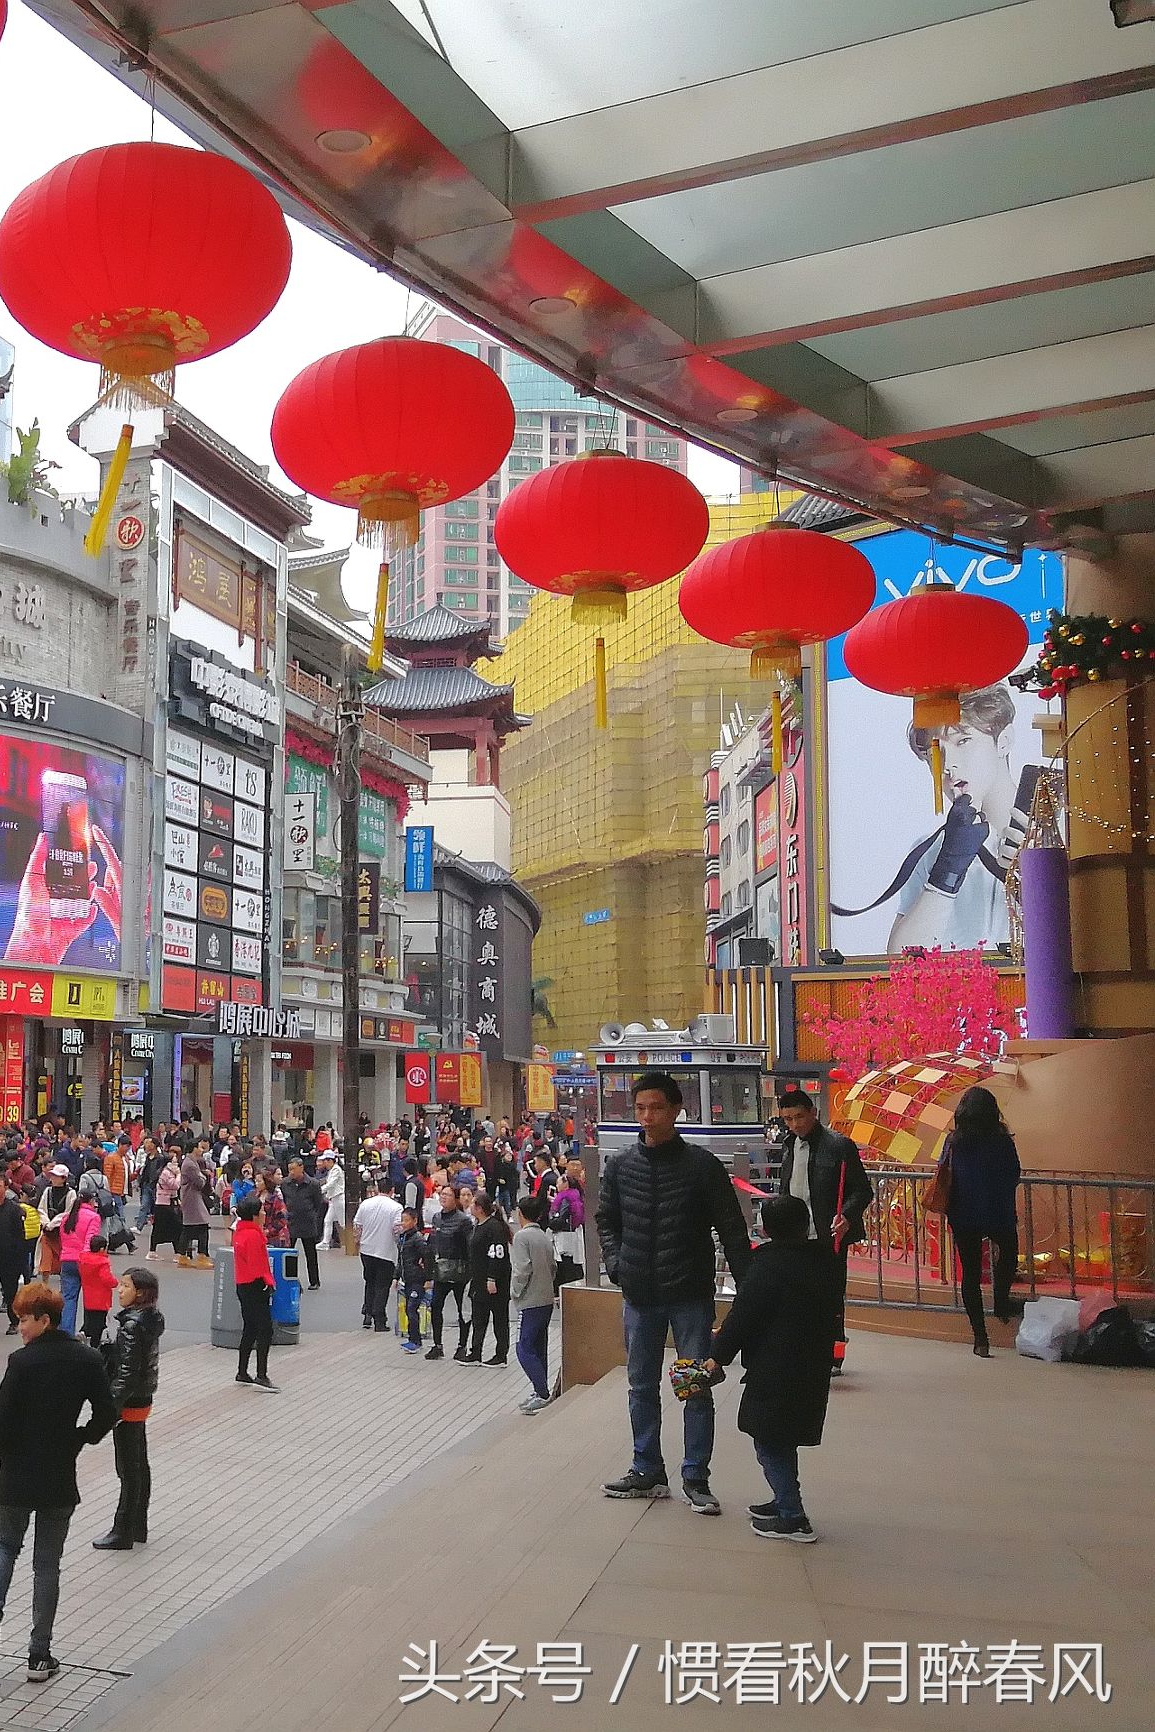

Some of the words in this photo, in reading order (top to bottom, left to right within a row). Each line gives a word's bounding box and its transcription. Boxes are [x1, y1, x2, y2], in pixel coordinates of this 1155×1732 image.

[476, 905, 500, 1039] 德奥商城
[219, 1000, 301, 1038] 鸿展中心城
[652, 1052, 681, 1063] POLICE
[7, 1106, 19, 1122] 39
[487, 1244, 504, 1259] 48
